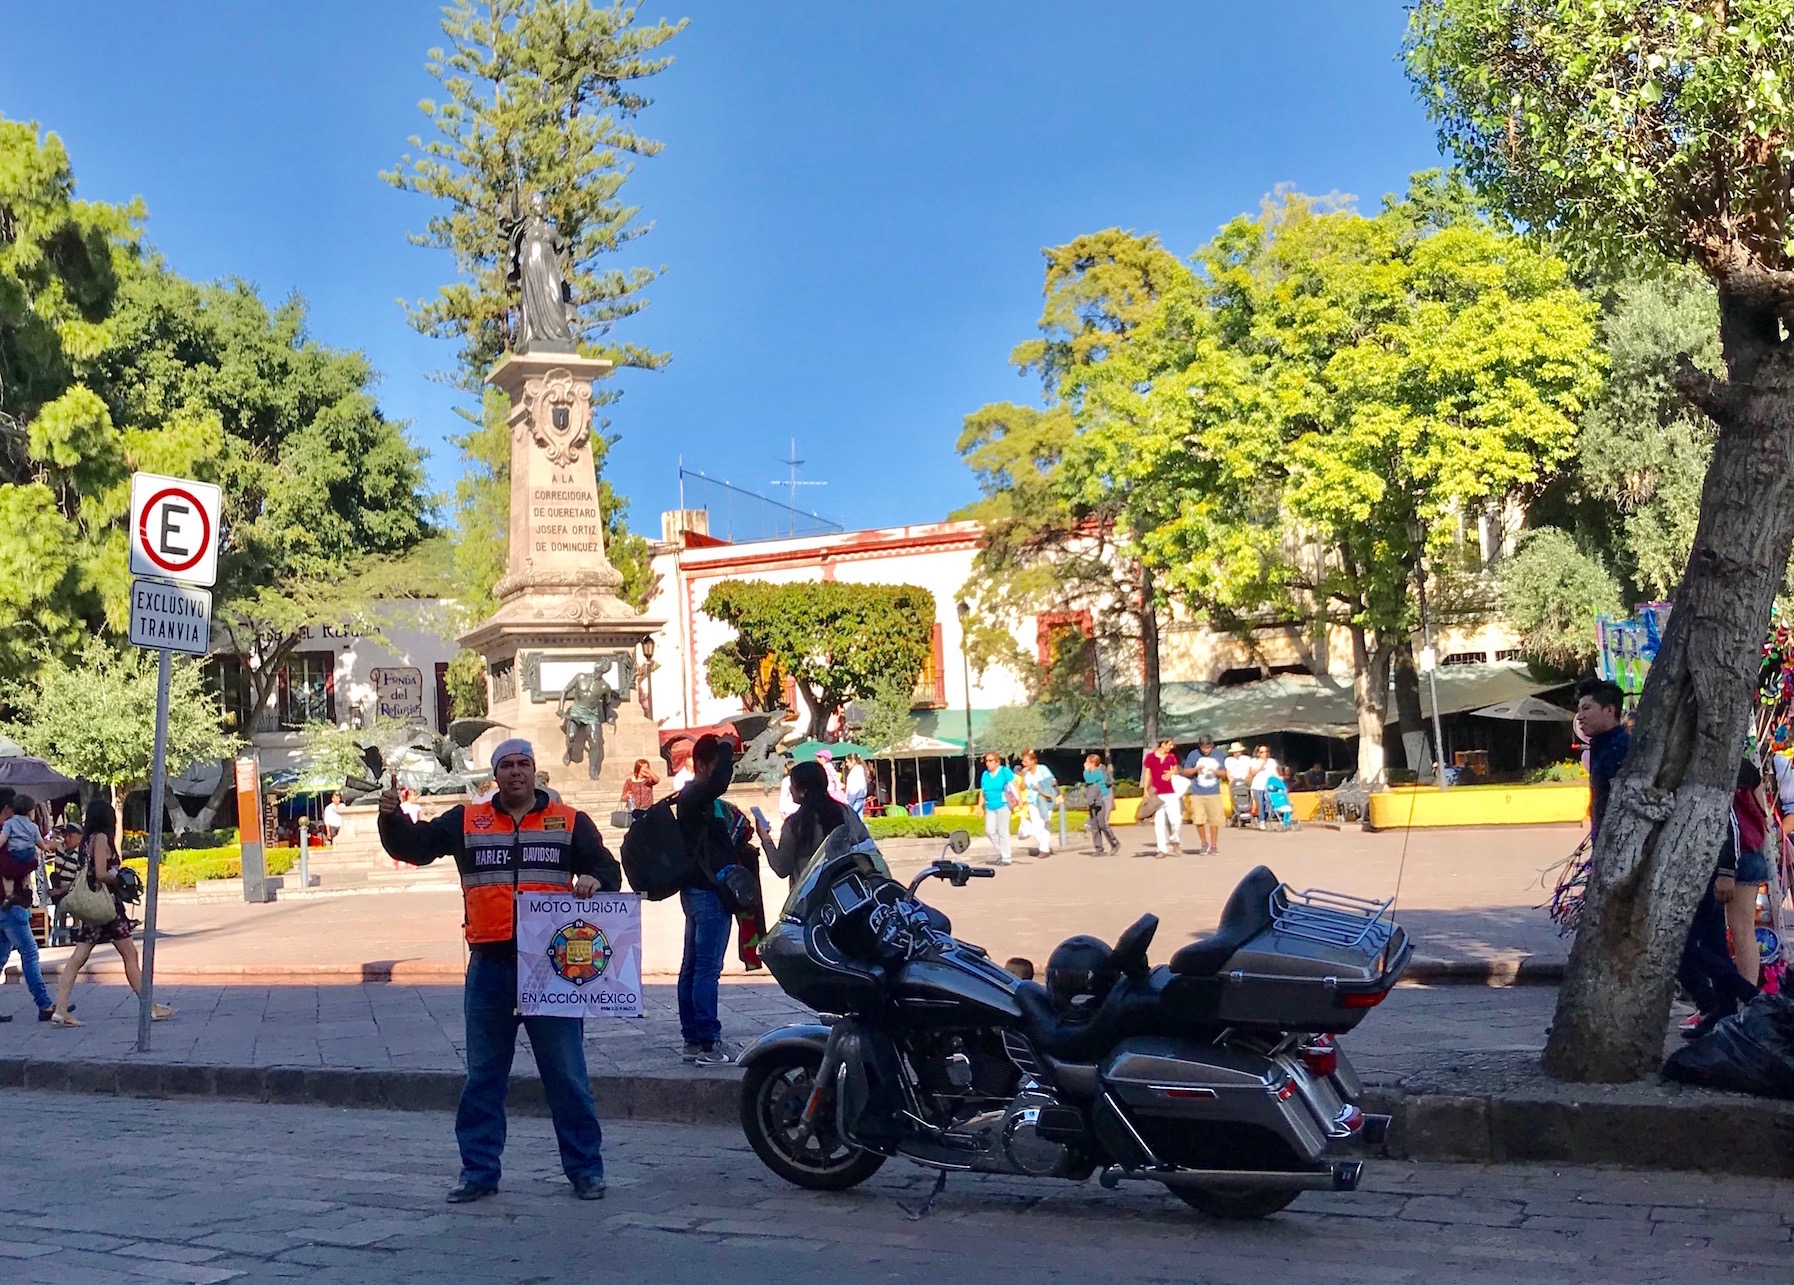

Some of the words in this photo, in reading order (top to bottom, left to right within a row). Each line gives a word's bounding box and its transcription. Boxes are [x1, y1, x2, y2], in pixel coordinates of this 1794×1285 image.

[551, 474, 558, 484] A
[561, 474, 574, 484] LA
[534, 507, 545, 517] DE
[547, 508, 596, 518] QUERETARO
[160, 503, 189, 556] E
[535, 525, 568, 535] JOSEFA
[572, 525, 597, 535] ORTIZ
[535, 542, 547, 552] DE
[137, 591, 204, 618] EXCLUSIVO
[140, 617, 199, 642] TRANVIA
[390, 688, 408, 700] del
[522, 847, 561, 864] DAVIDSON
[530, 901, 572, 914] MOTO
[575, 901, 628, 914] TURISTA
[521, 992, 537, 1004] EN
[539, 990, 588, 1004] ACCIÓN
[590, 990, 637, 1004] MÉXICO
